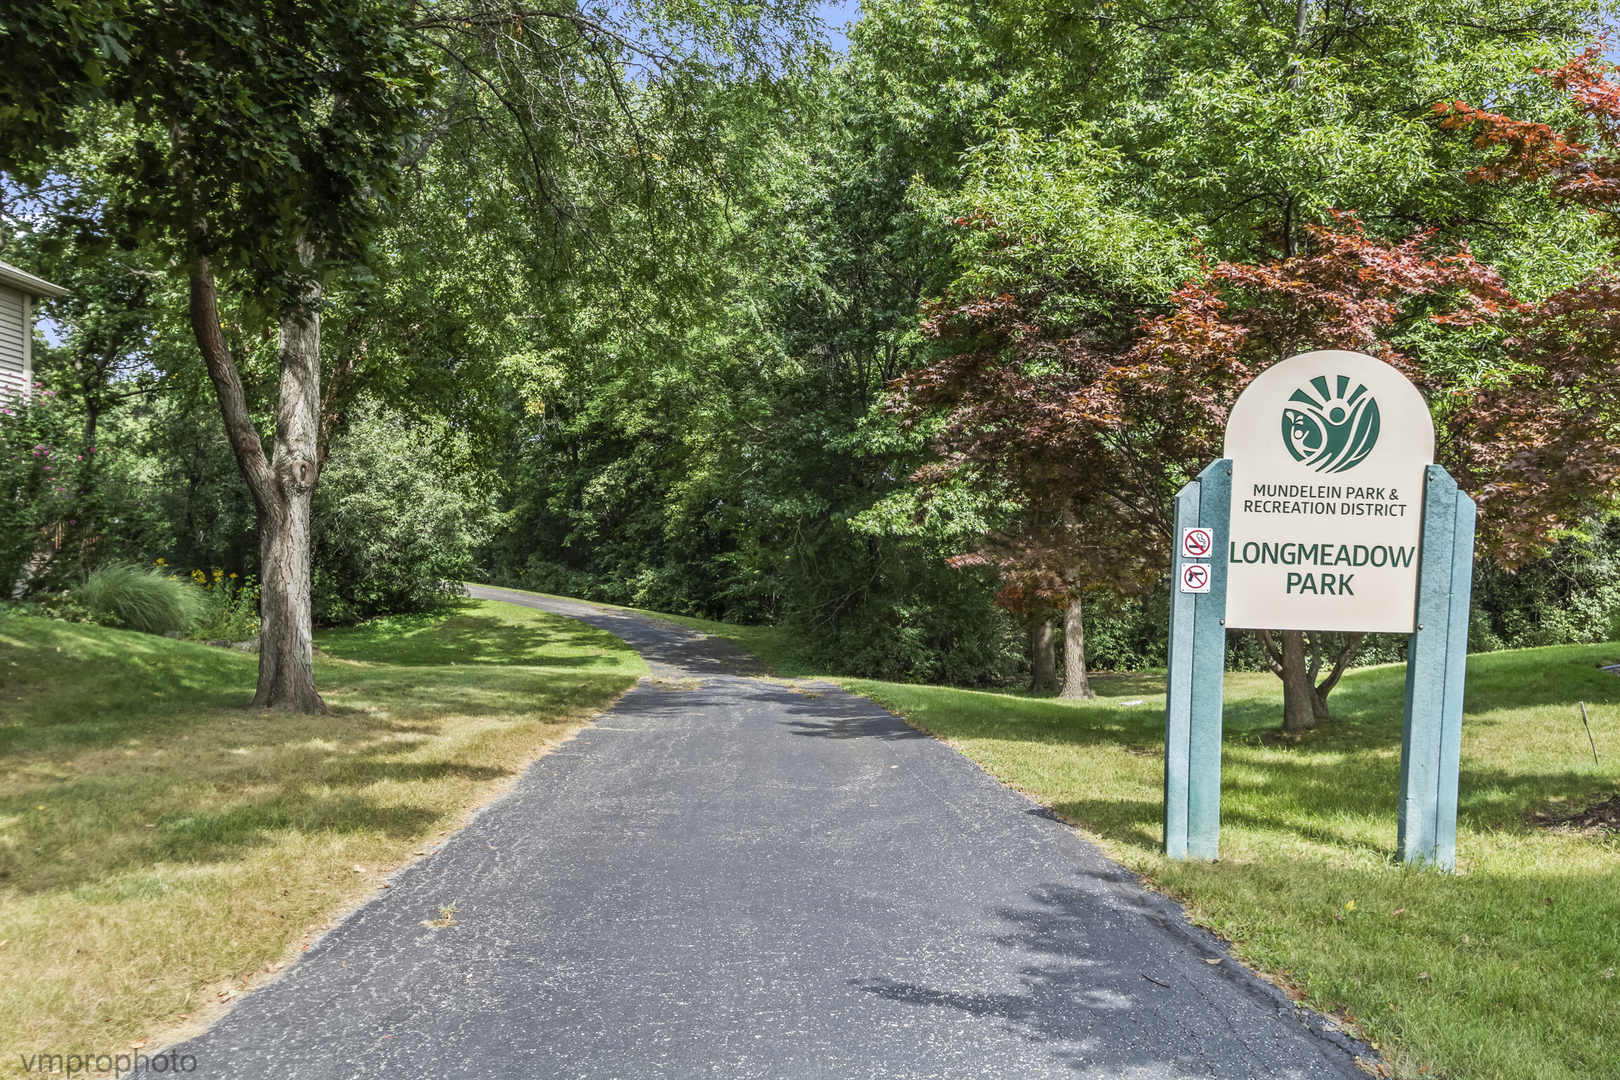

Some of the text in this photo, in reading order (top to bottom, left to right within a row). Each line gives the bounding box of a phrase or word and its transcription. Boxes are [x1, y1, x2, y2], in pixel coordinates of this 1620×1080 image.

[1253, 484, 1399, 501] MUNDELEIN PARK &
[1244, 500, 1407, 517] RECREATION DISTRICT
[1229, 541, 1416, 568] LONGMEADOW
[1286, 572, 1355, 596] PARK
